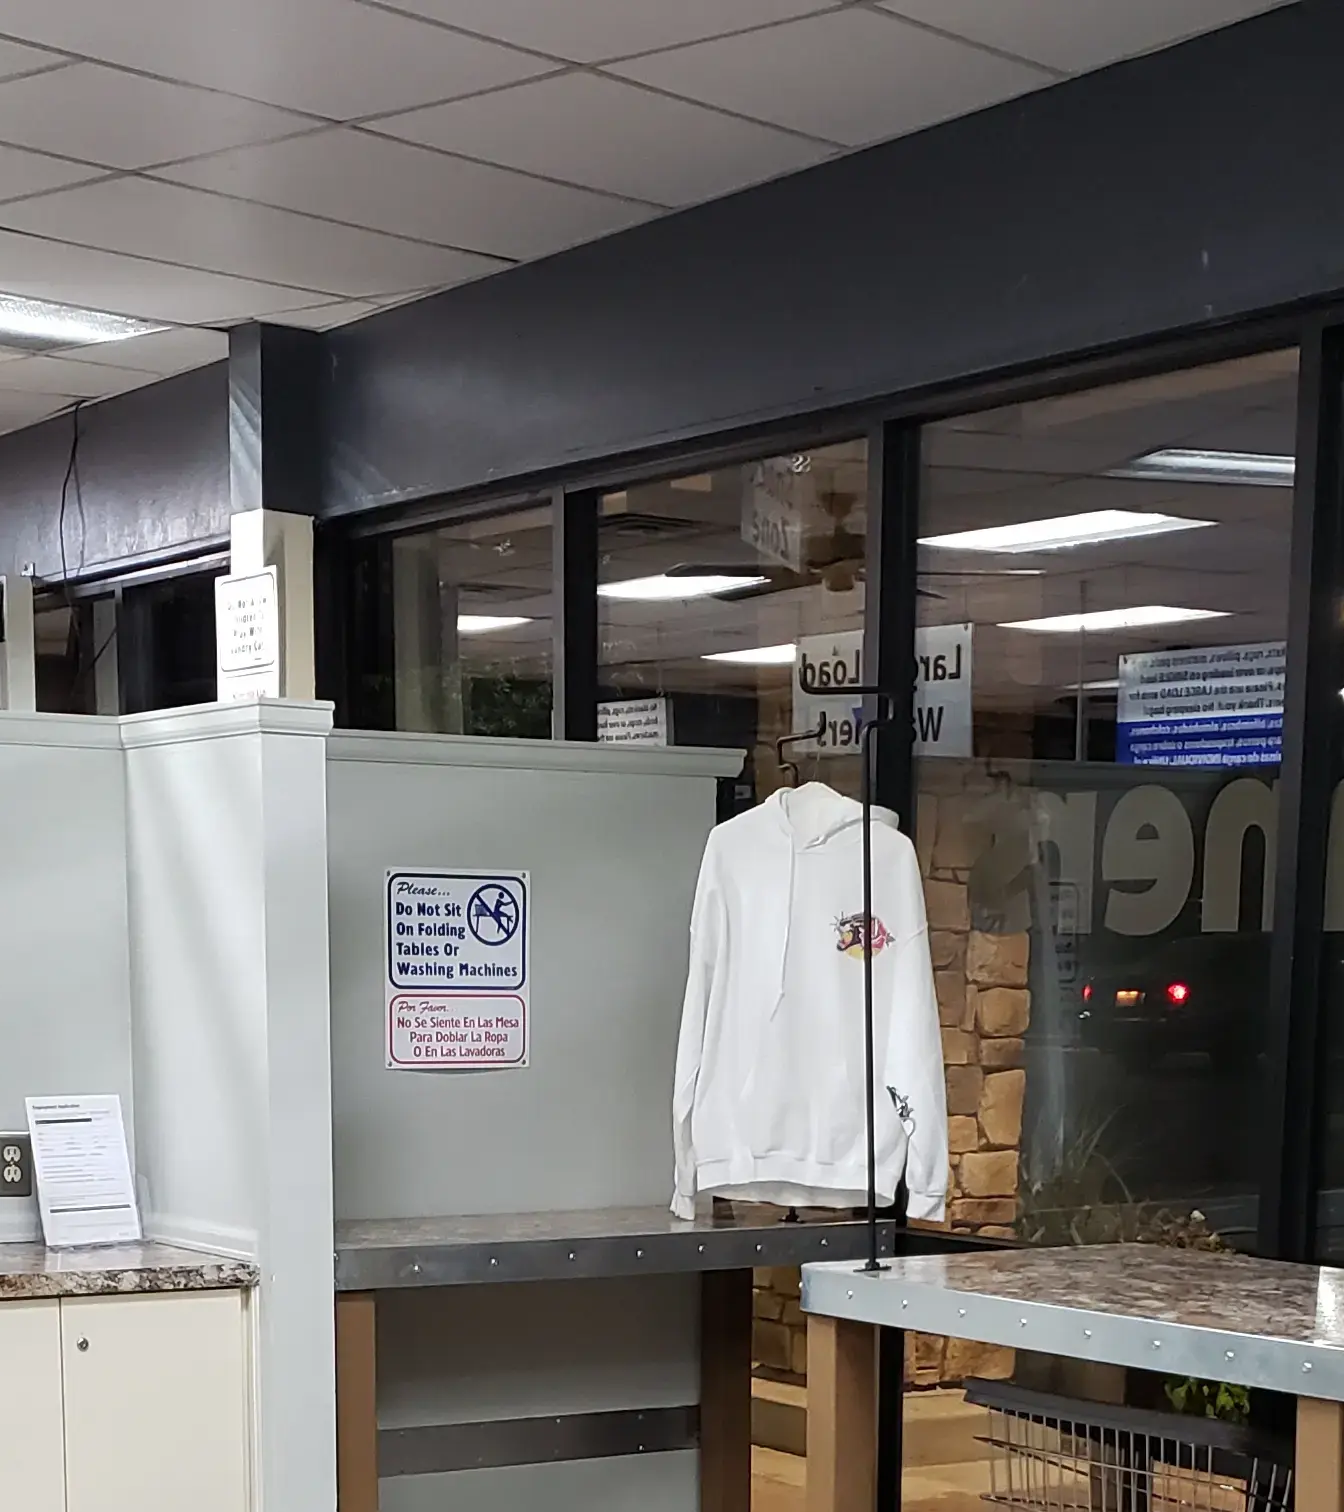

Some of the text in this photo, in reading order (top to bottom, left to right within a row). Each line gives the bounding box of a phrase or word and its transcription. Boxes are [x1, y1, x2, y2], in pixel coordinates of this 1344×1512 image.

[396, 881, 451, 897] Please...
[395, 902, 462, 918] Do Not Sit
[396, 922, 466, 940] On Folding
[396, 942, 460, 957] Tables Or
[397, 962, 518, 980] Washing Machines
[398, 1001, 416, 1014] Por
[397, 1016, 519, 1029] No Se Siente En Las Mesa
[409, 1031, 509, 1045] Para Doblar La Ropa
[413, 1045, 505, 1058] O En Las Lavadoras
